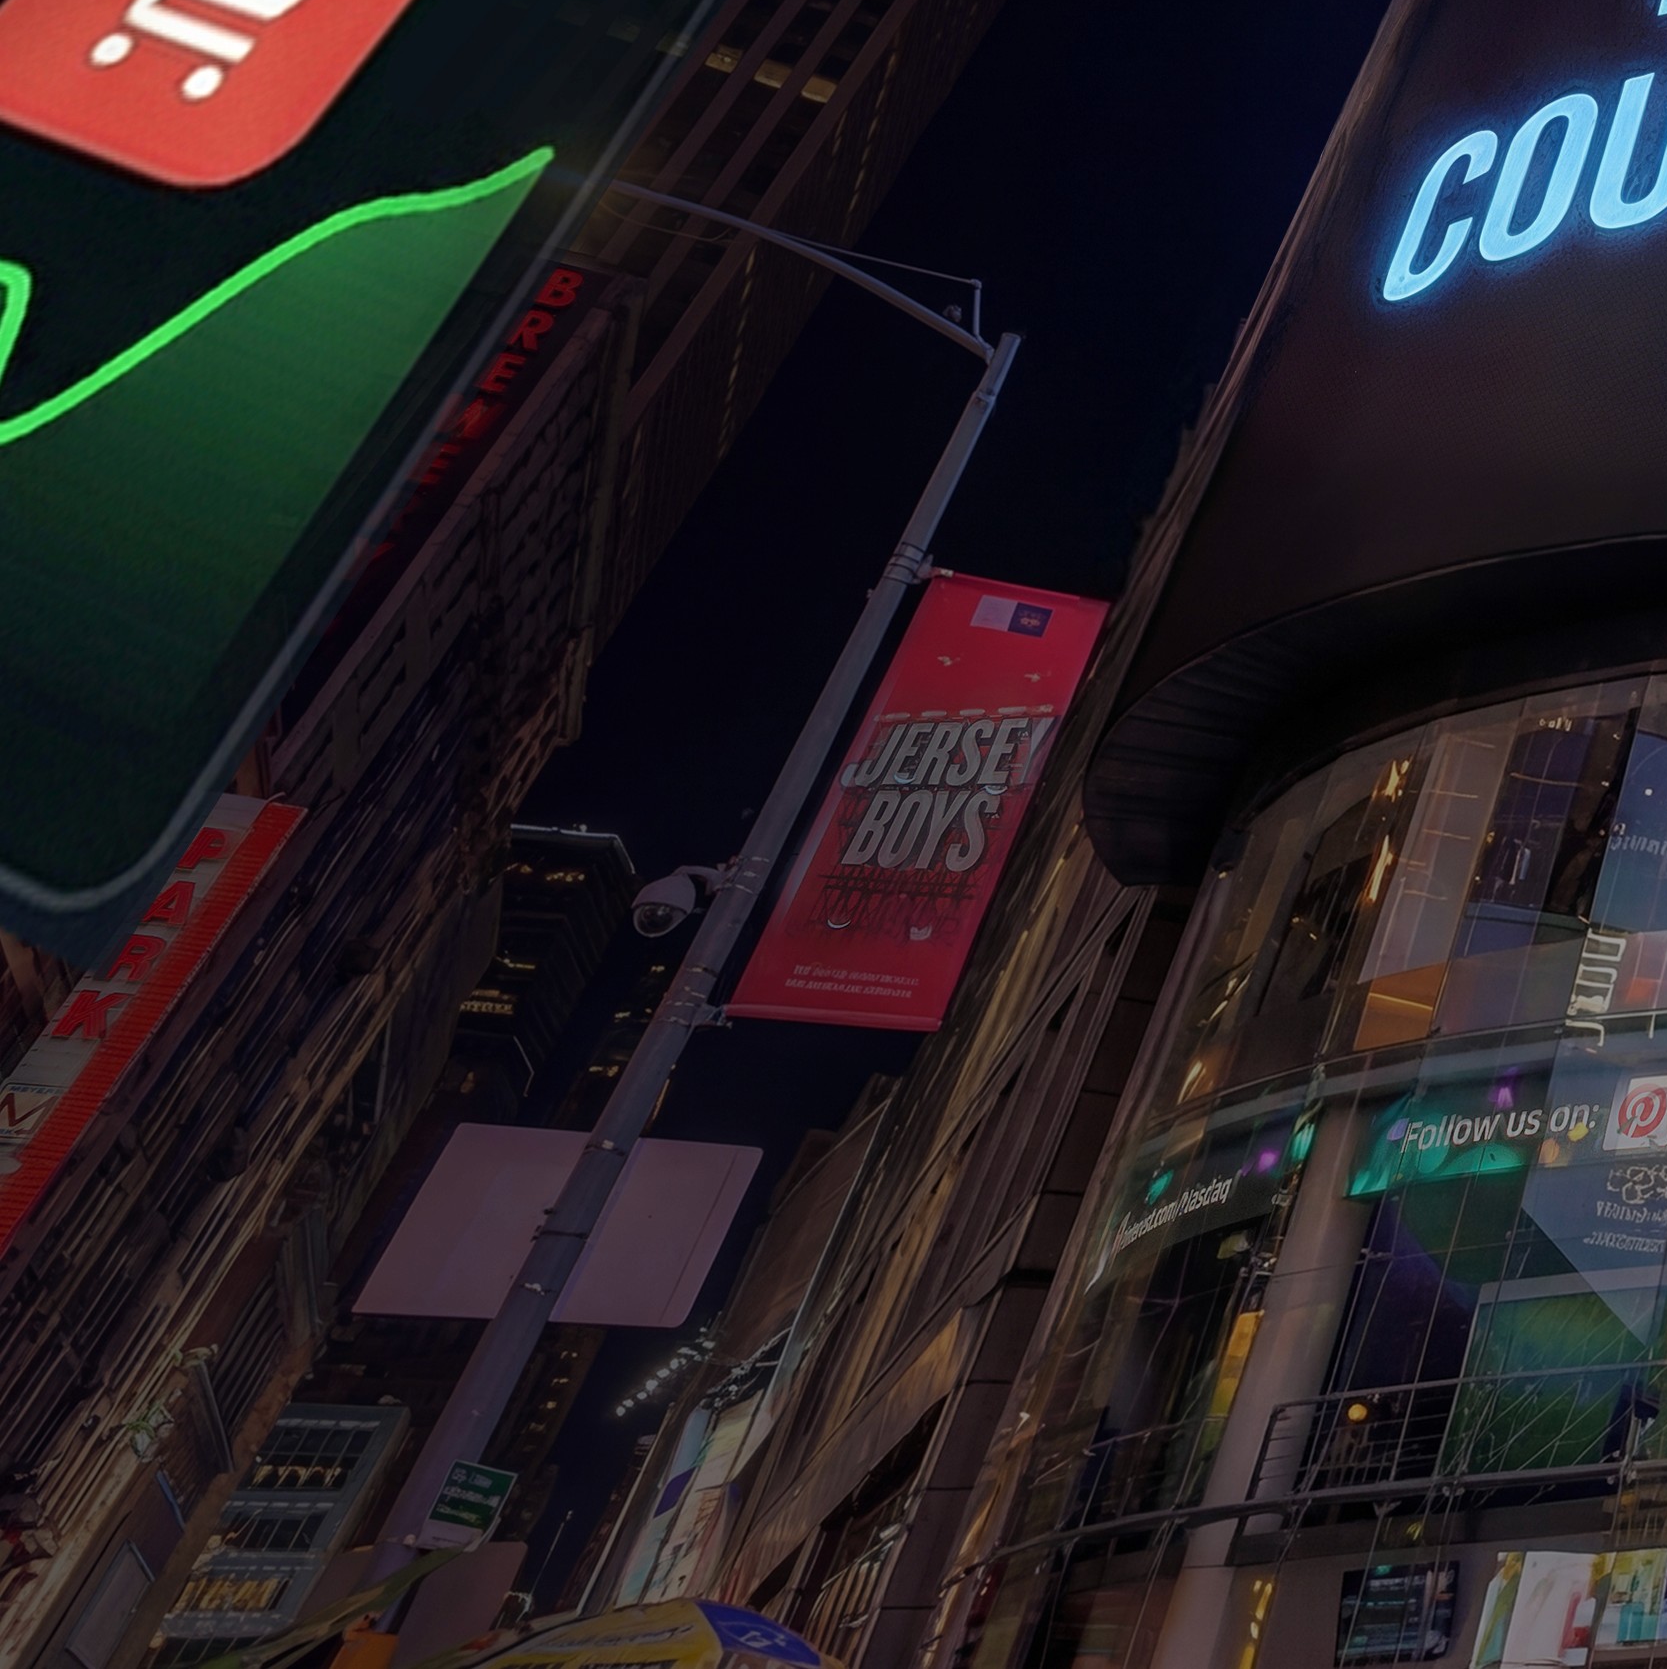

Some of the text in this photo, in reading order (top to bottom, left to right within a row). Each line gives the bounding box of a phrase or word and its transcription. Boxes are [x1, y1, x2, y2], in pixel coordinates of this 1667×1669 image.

[854, 717, 1054, 787] JERSEY
[840, 789, 1001, 872] BOYS
[52, 827, 230, 1040] PARK
[1401, 1101, 1600, 1153] Follow us on:
